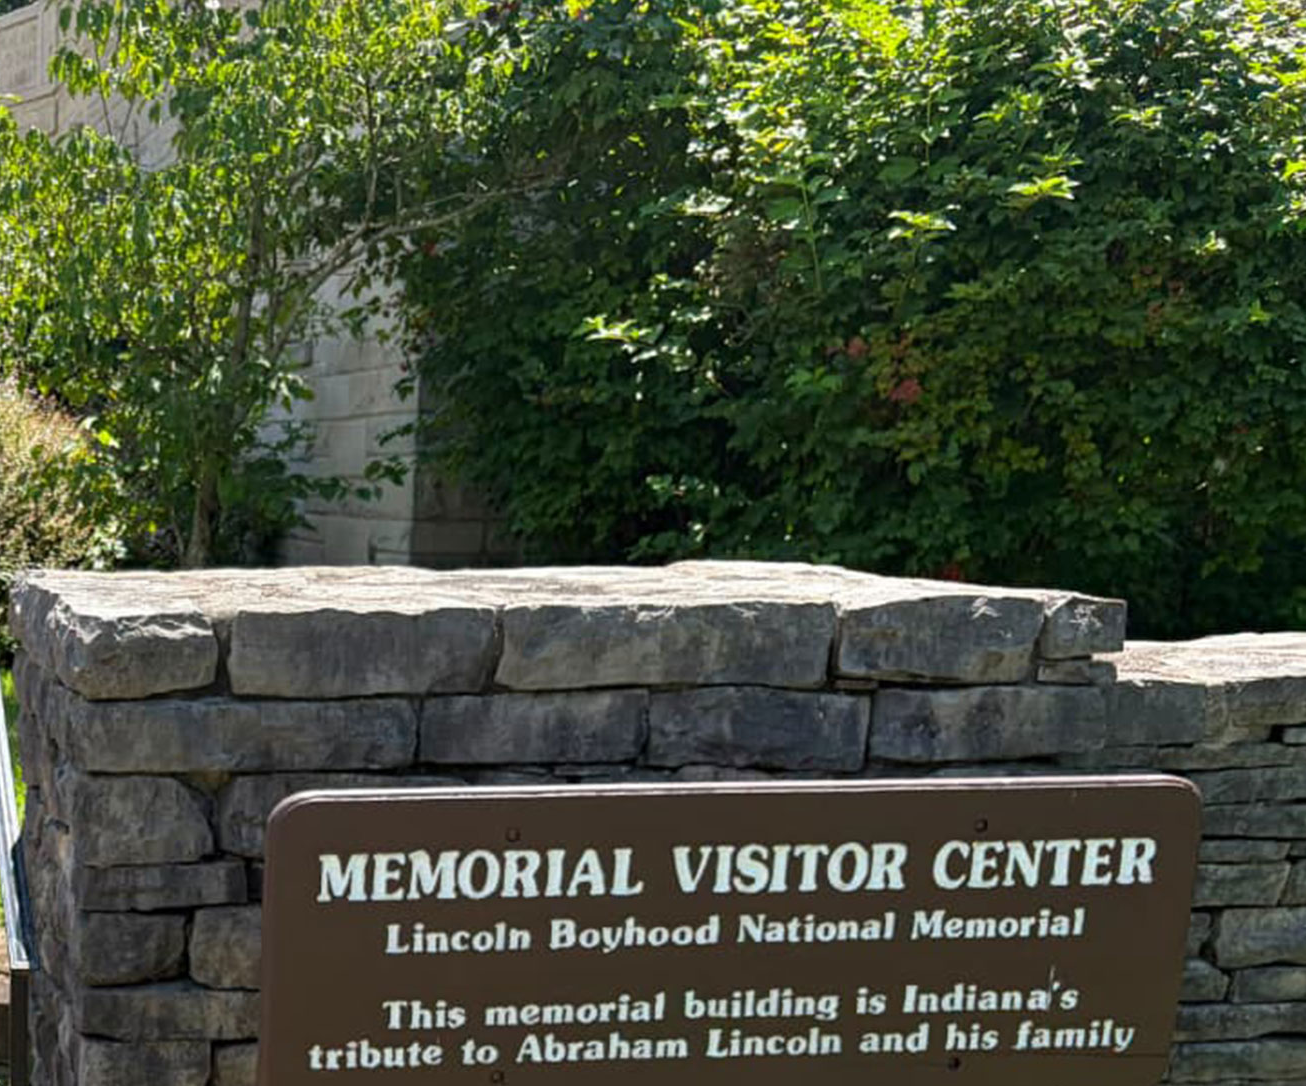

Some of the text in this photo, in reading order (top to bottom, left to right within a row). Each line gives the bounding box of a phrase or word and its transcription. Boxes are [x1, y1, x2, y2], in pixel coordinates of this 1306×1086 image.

[316, 837, 1156, 902] MEMORIAL VISITOR CENTER
[385, 907, 1085, 954] Lincoln Boyhood National Memorial
[382, 980, 1079, 1030] This memorial building is Indiana's
[309, 1018, 1136, 1070] tribute to Abraham Lincoln and his family
